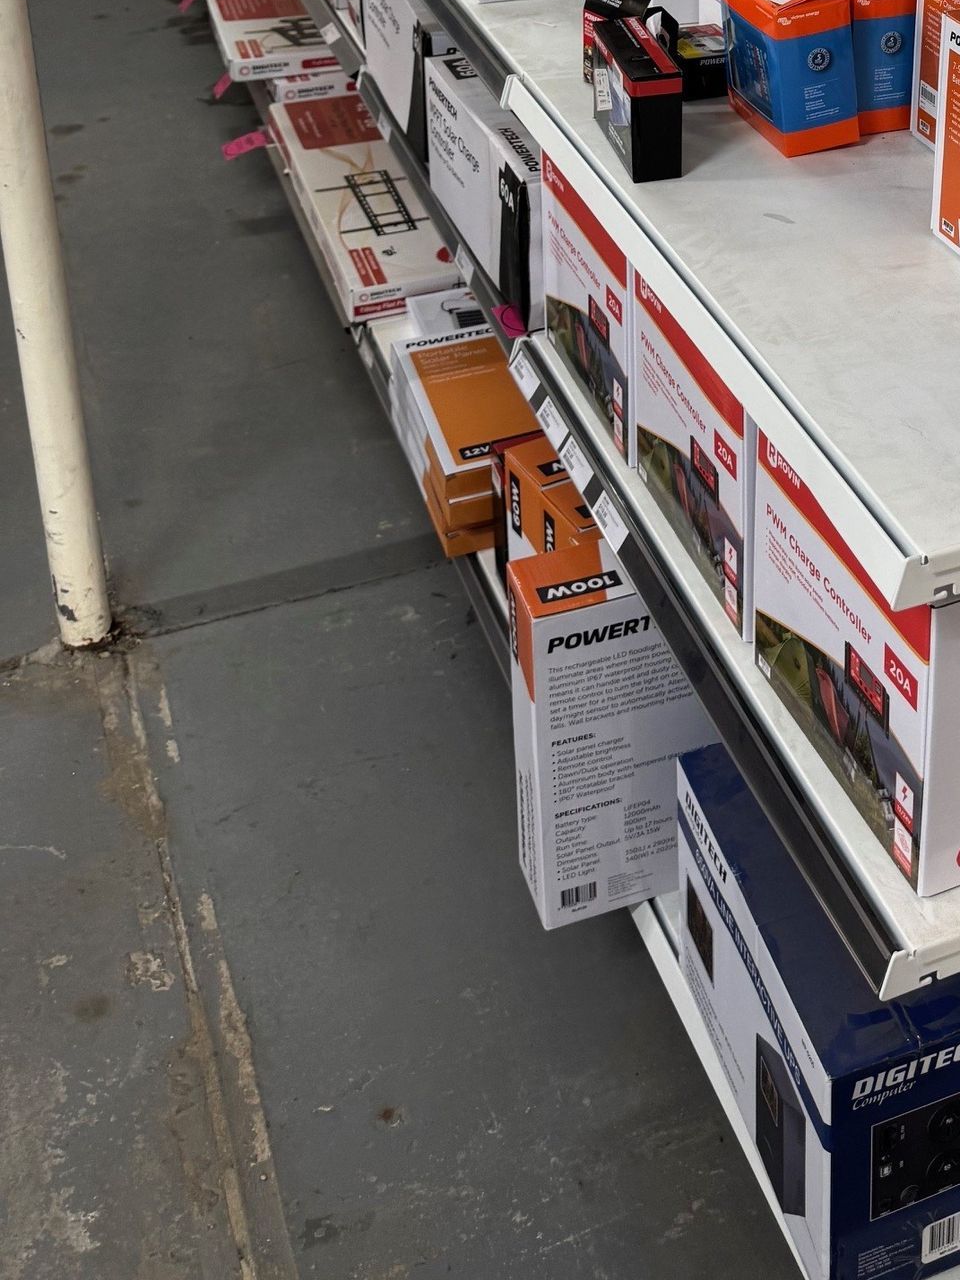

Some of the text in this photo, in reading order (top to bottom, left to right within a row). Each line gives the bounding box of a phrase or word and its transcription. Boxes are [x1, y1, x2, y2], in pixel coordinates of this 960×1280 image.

[498, 127, 541, 172] POWERTECH
[501, 178, 514, 213] 60A
[606, 292, 622, 318] 20A
[406, 328, 493, 349] POWERTEC
[640, 330, 707, 434] PWM Charge Controller
[464, 445, 490, 458] 12V
[716, 440, 735, 472] 20A
[776, 455, 801, 491] ROVIN
[510, 480, 520, 526] 60W
[547, 575, 615, 599] 100W
[766, 502, 787, 539] PWM
[789, 534, 822, 582] Charge
[823, 576, 872, 645] Controller
[547, 615, 651, 654] POWERT
[889, 659, 913, 697] 20A
[552, 733, 596, 747] FEATURES:
[557, 743, 631, 765] Adjustable brightness
[576, 736, 624, 753] panel charger
[587, 755, 612, 764] control
[555, 798, 622, 819] SPECIFICATIONS:
[685, 790, 728, 884] DIGITECH
[716, 892, 734, 931] LINE
[733, 926, 784, 1046] INTERACTIVE
[784, 1044, 801, 1085] UPS
[851, 1080, 917, 1112] Computer
